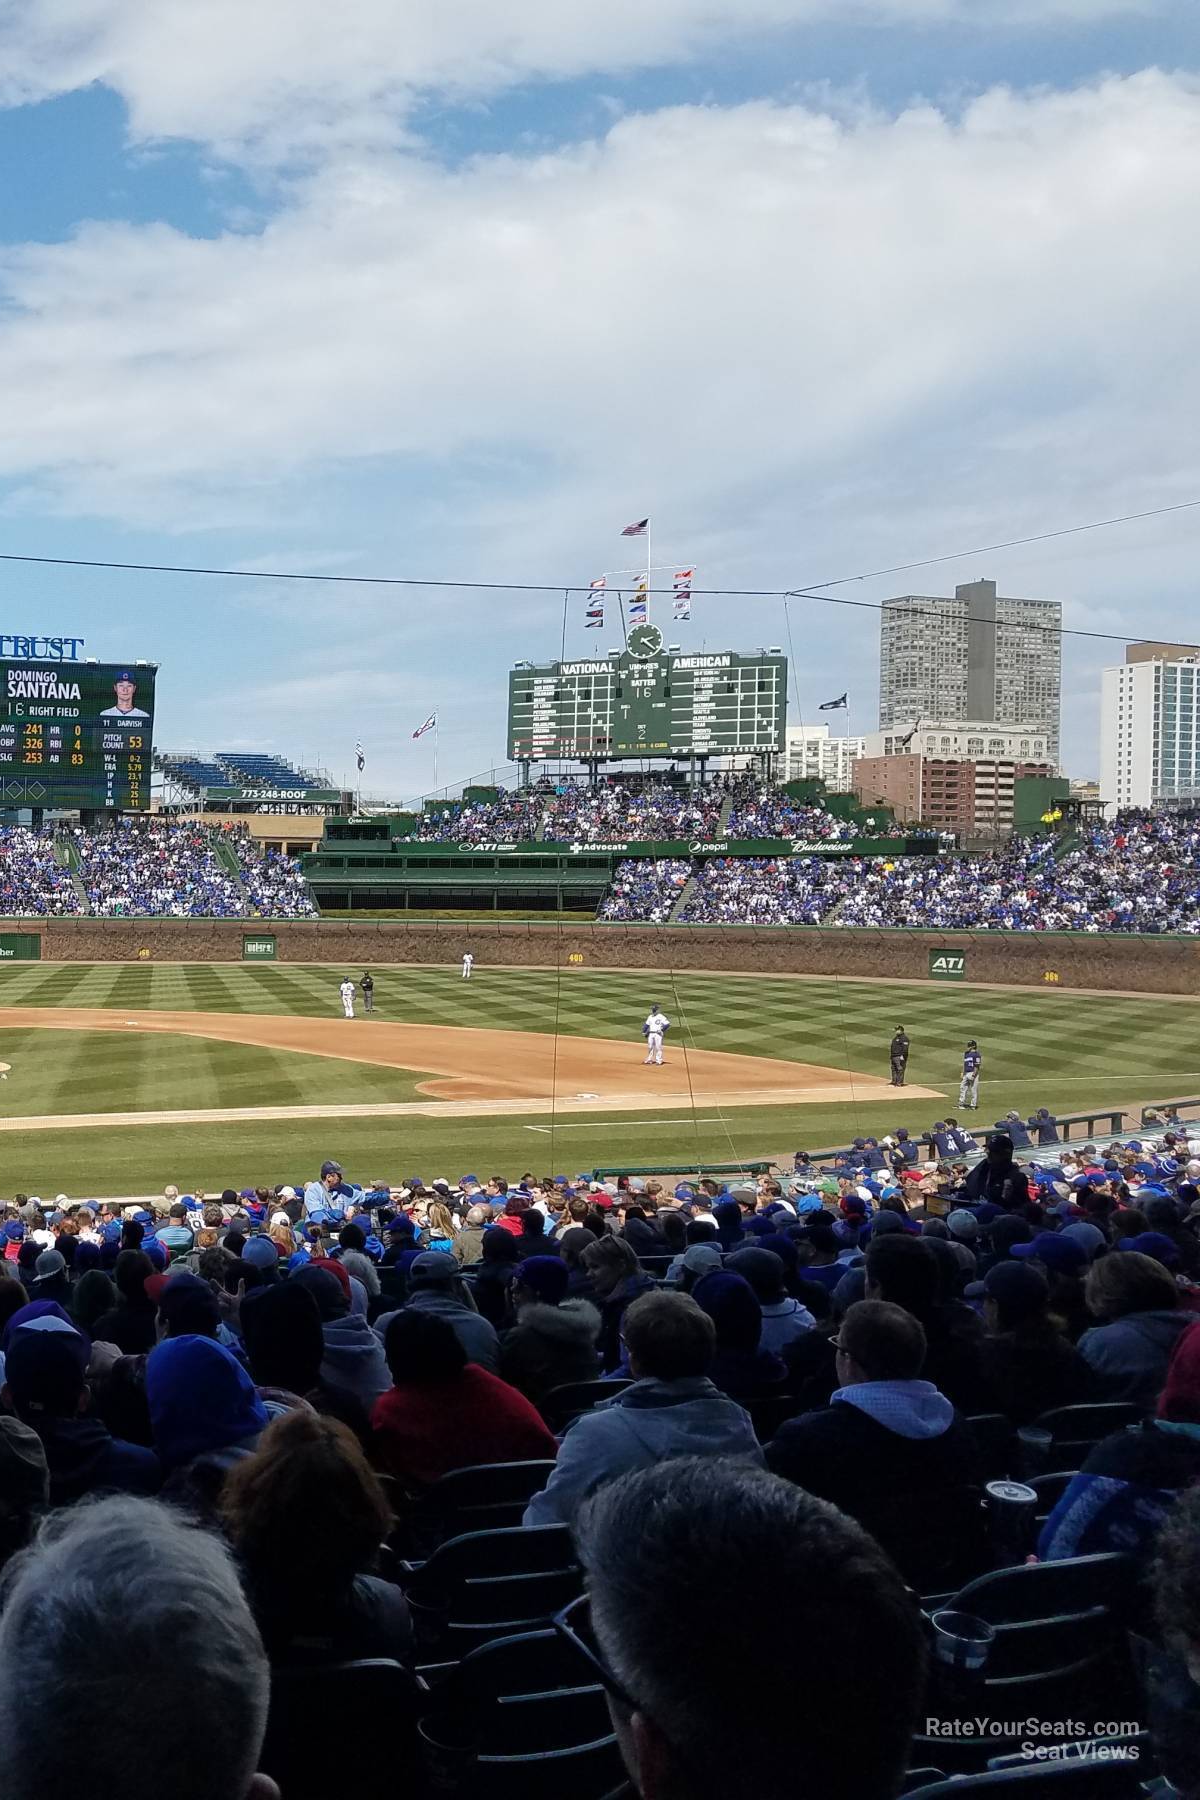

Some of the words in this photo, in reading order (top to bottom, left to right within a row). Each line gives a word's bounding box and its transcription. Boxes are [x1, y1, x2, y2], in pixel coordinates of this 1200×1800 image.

[560, 662, 615, 675] NATIONAL
[672, 656, 730, 669] AMERICAN
[8, 670, 57, 682] DOMINGO
[8, 682, 81, 699] SANTANA
[636, 687, 652, 698] 16
[29, 707, 54, 716] RIGHT
[57, 708, 79, 717] FIELD
[0, 725, 15, 733] AVG
[23, 724, 43, 735] .241
[50, 727, 60, 735] HR
[638, 729, 646, 740] 2
[23, 738, 43, 749] .326
[50, 740, 62, 748] RBI
[74, 740, 81, 750] 4
[102, 741, 124, 749] COUNT
[129, 736, 142, 748] 53
[104, 734, 122, 742] PITCH
[0, 753, 13, 761] SLG
[22, 752, 43, 764] .253
[50, 755, 60, 763] AB
[71, 754, 84, 764] 83
[104, 763, 116, 771] ERA
[241, 789, 307, 799] 773-248-ROOF
[701, 843, 728, 851] pepsi
[790, 840, 853, 852] Budweiser
[932, 957, 964, 969] ATI
